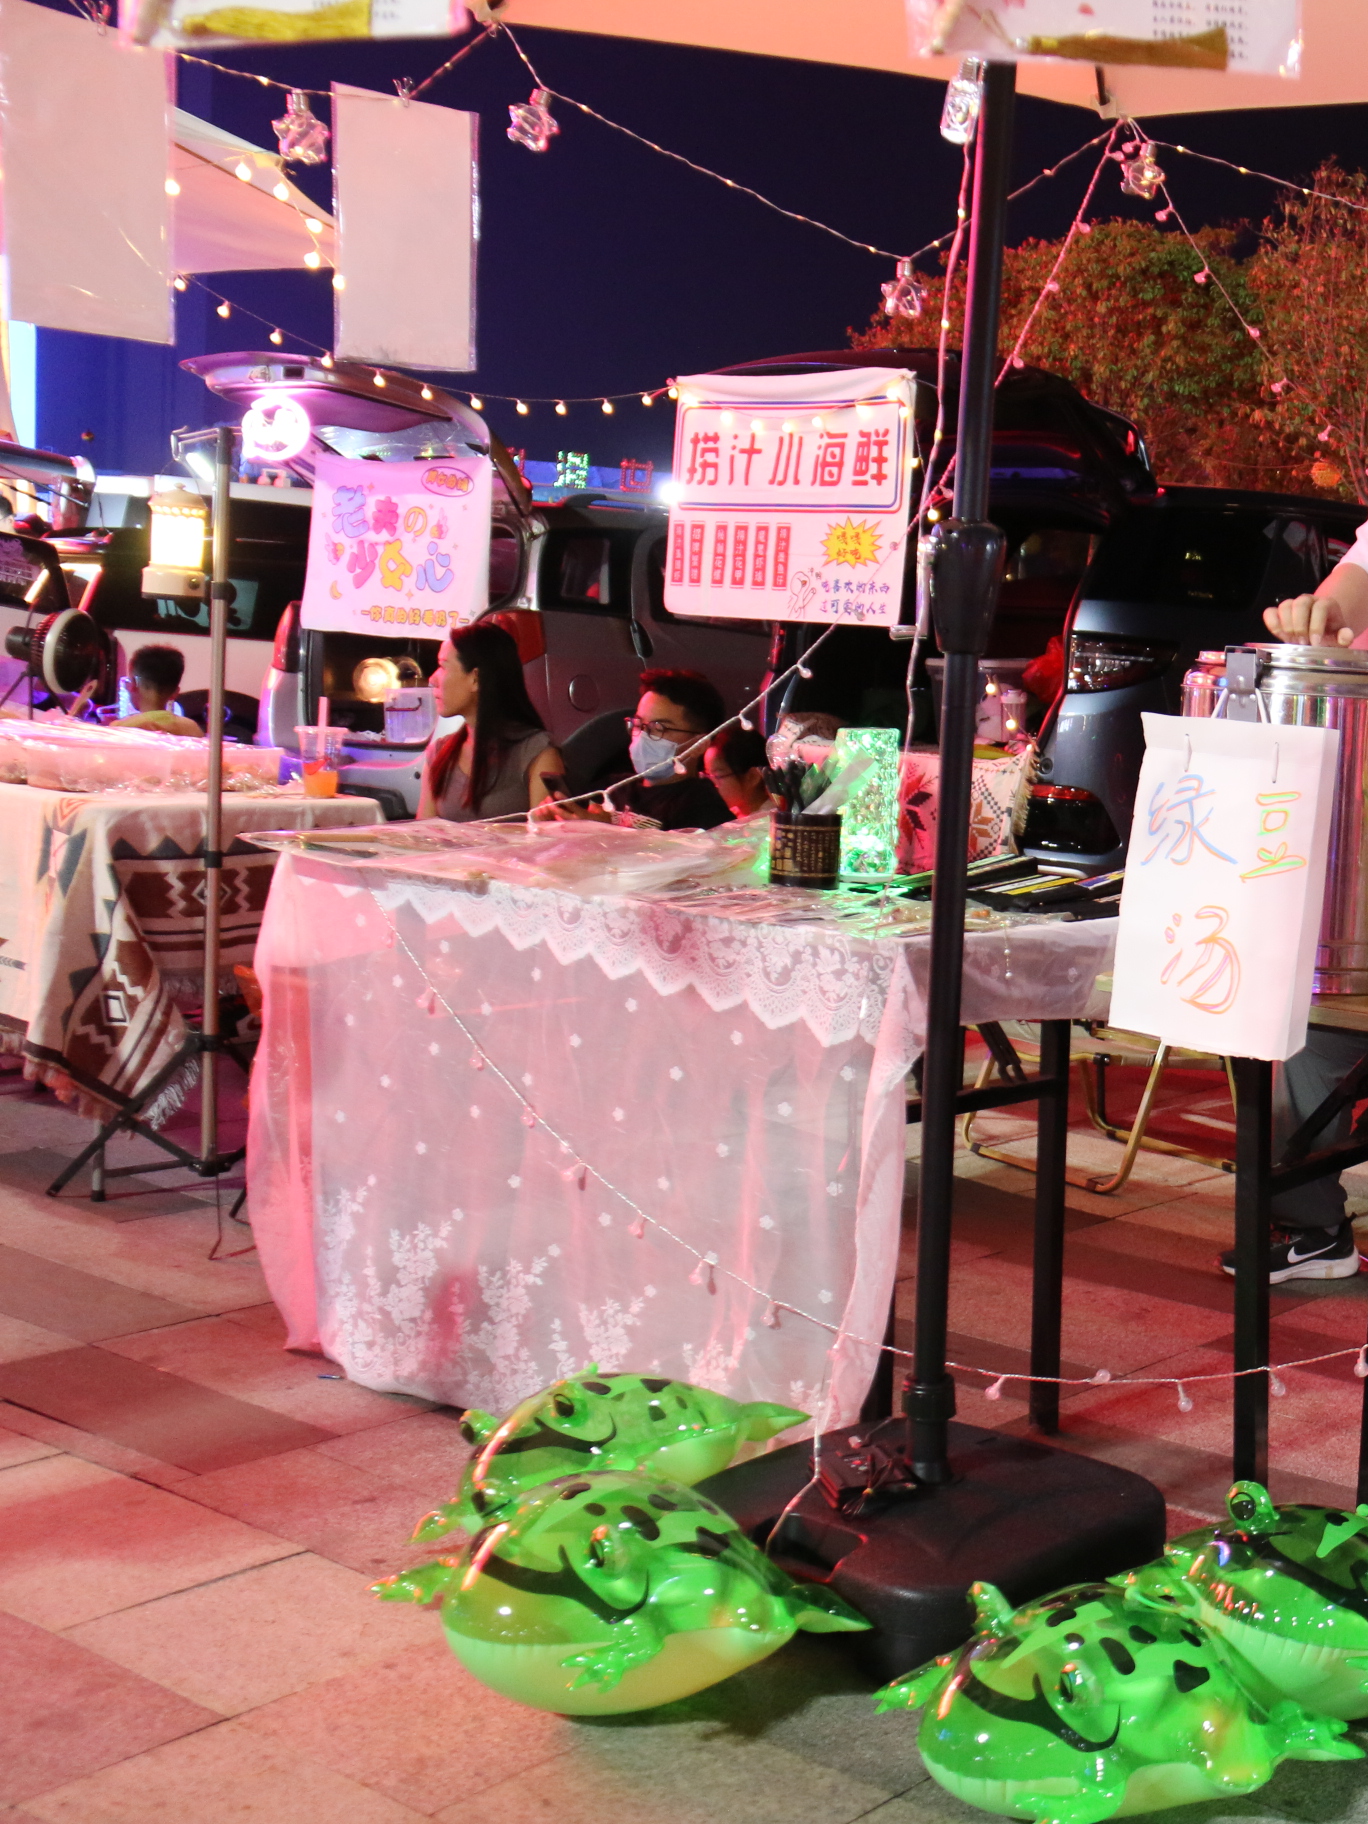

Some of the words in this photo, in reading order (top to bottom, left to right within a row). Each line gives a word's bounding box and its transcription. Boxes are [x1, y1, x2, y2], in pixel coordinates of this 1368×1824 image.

[686, 428, 890, 487] 捞汁小海鲜
[347, 538, 454, 593] 少女心
[1160, 904, 1241, 1014] 汤
